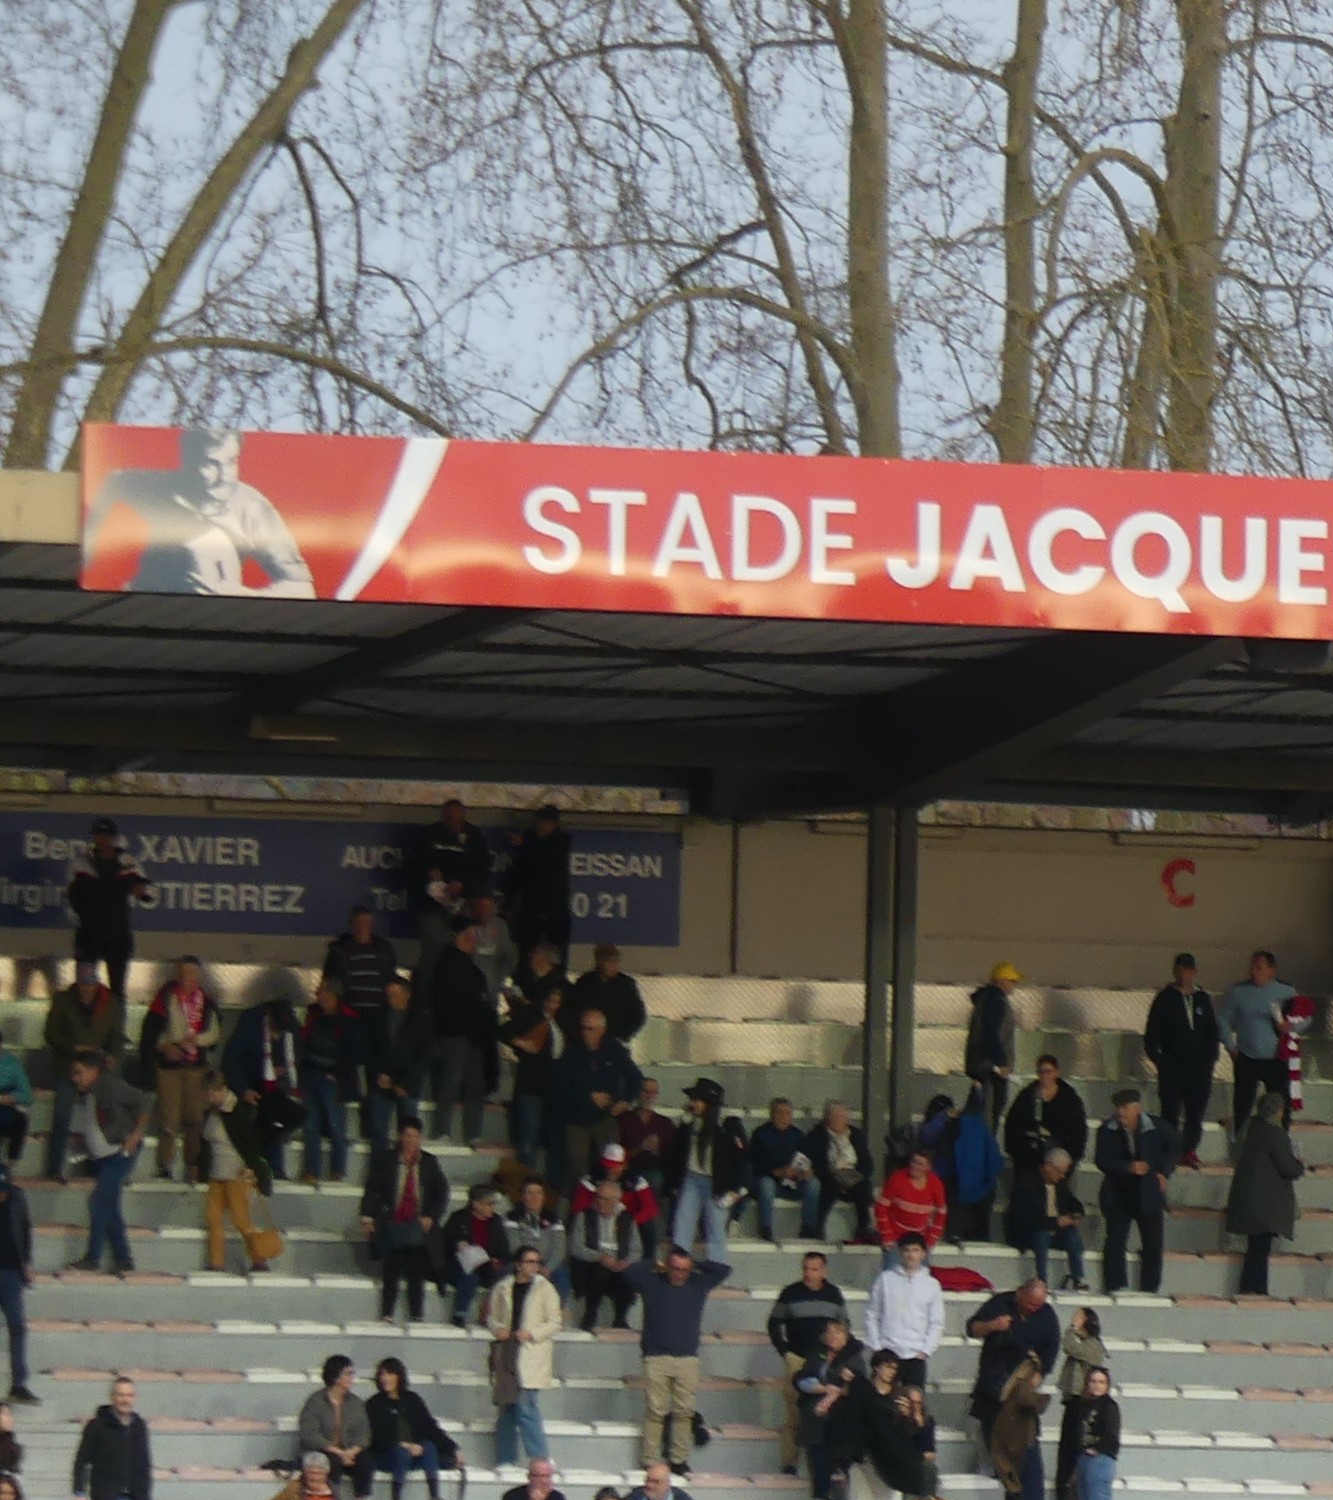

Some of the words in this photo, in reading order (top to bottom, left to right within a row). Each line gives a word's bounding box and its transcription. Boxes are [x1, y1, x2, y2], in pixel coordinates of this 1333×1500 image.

[522, 486, 857, 586] STADE
[138, 833, 260, 867] XAVIER
[341, 845, 405, 869] AUC
[570, 852, 663, 879] EISSAN
[1161, 856, 1196, 909] C
[597, 894, 628, 918] 21
